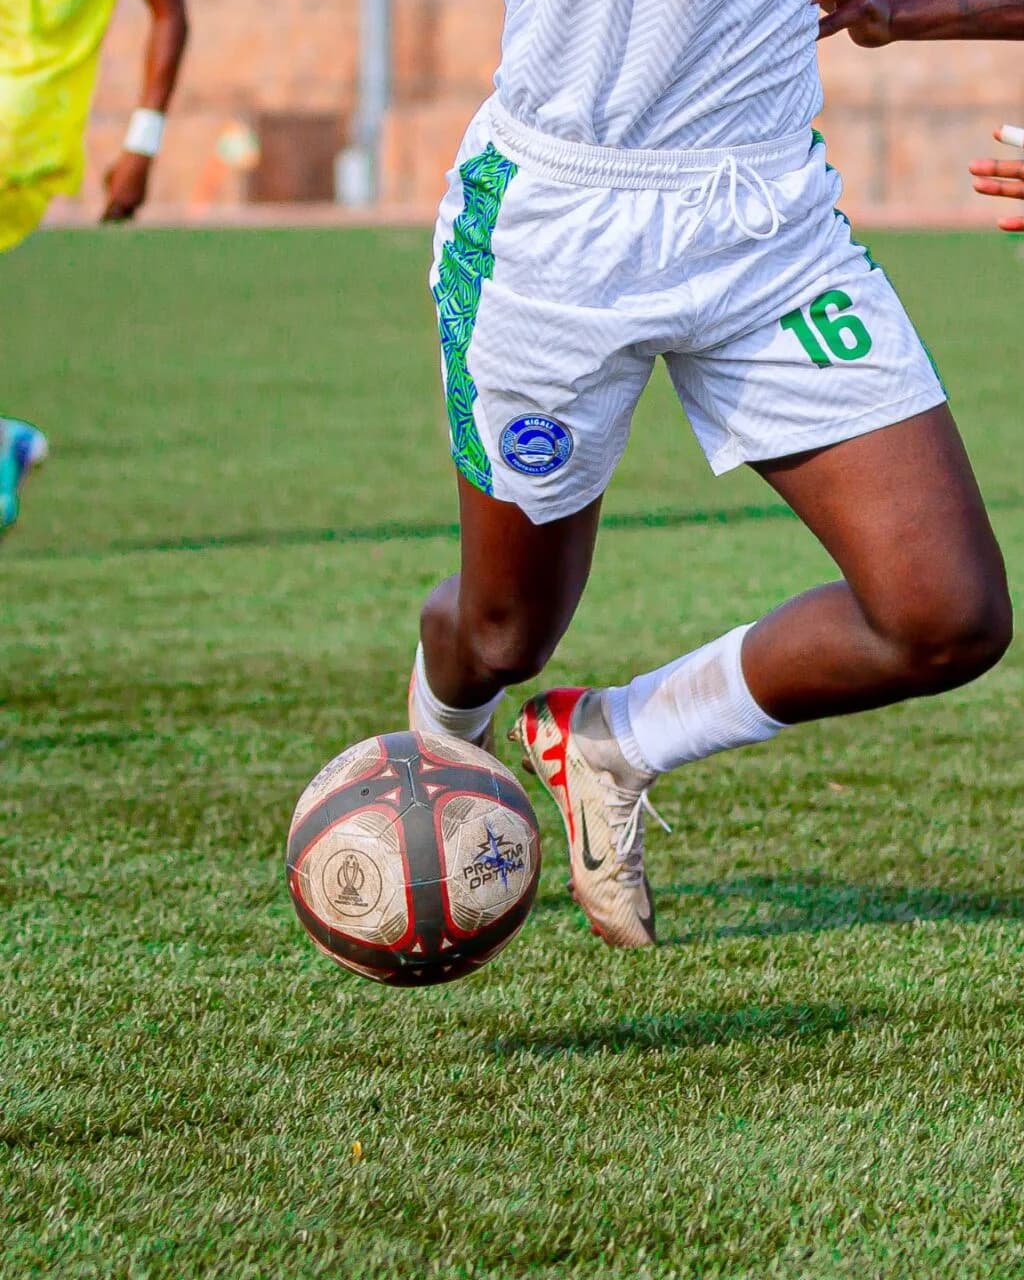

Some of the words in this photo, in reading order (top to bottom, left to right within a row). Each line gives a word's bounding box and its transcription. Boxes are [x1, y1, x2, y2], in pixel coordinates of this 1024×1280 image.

[780, 289, 873, 369] 16
[525, 418, 554, 429] KIGALI
[470, 858, 524, 889] OPTIMA
